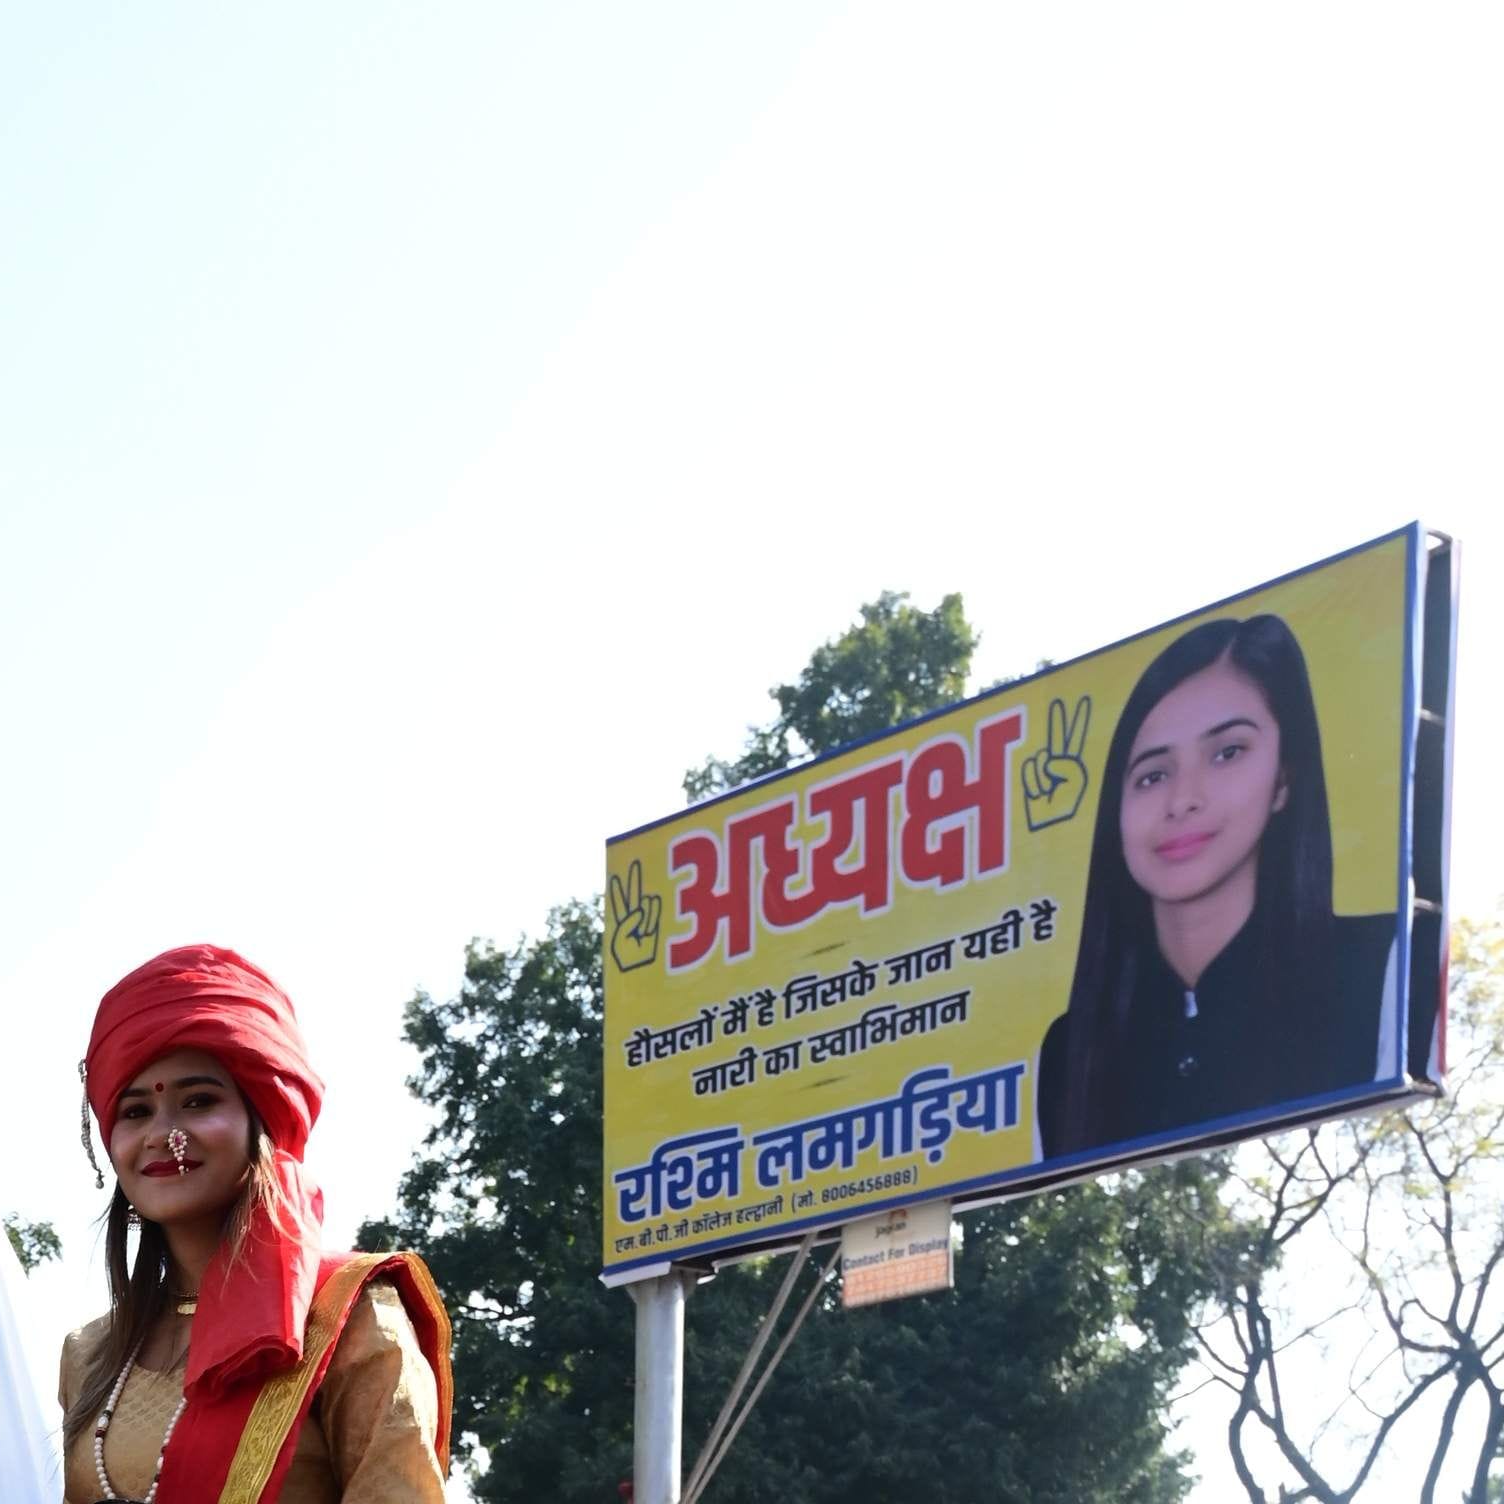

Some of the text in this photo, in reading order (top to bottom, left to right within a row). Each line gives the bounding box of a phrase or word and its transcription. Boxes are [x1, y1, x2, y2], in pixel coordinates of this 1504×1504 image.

[668, 709, 1023, 967] अध्यक्ष
[753, 989, 777, 1028] है
[785, 961, 878, 1020] जिसके
[885, 941, 952, 986] जान
[962, 910, 1023, 960] यही
[1031, 900, 1056, 941] है
[693, 990, 971, 1096] नारी का स्वाभिमान
[614, 1062, 1026, 1223] रश्मि लमगड़िया
[692, 1212, 732, 1236] कॉलेज
